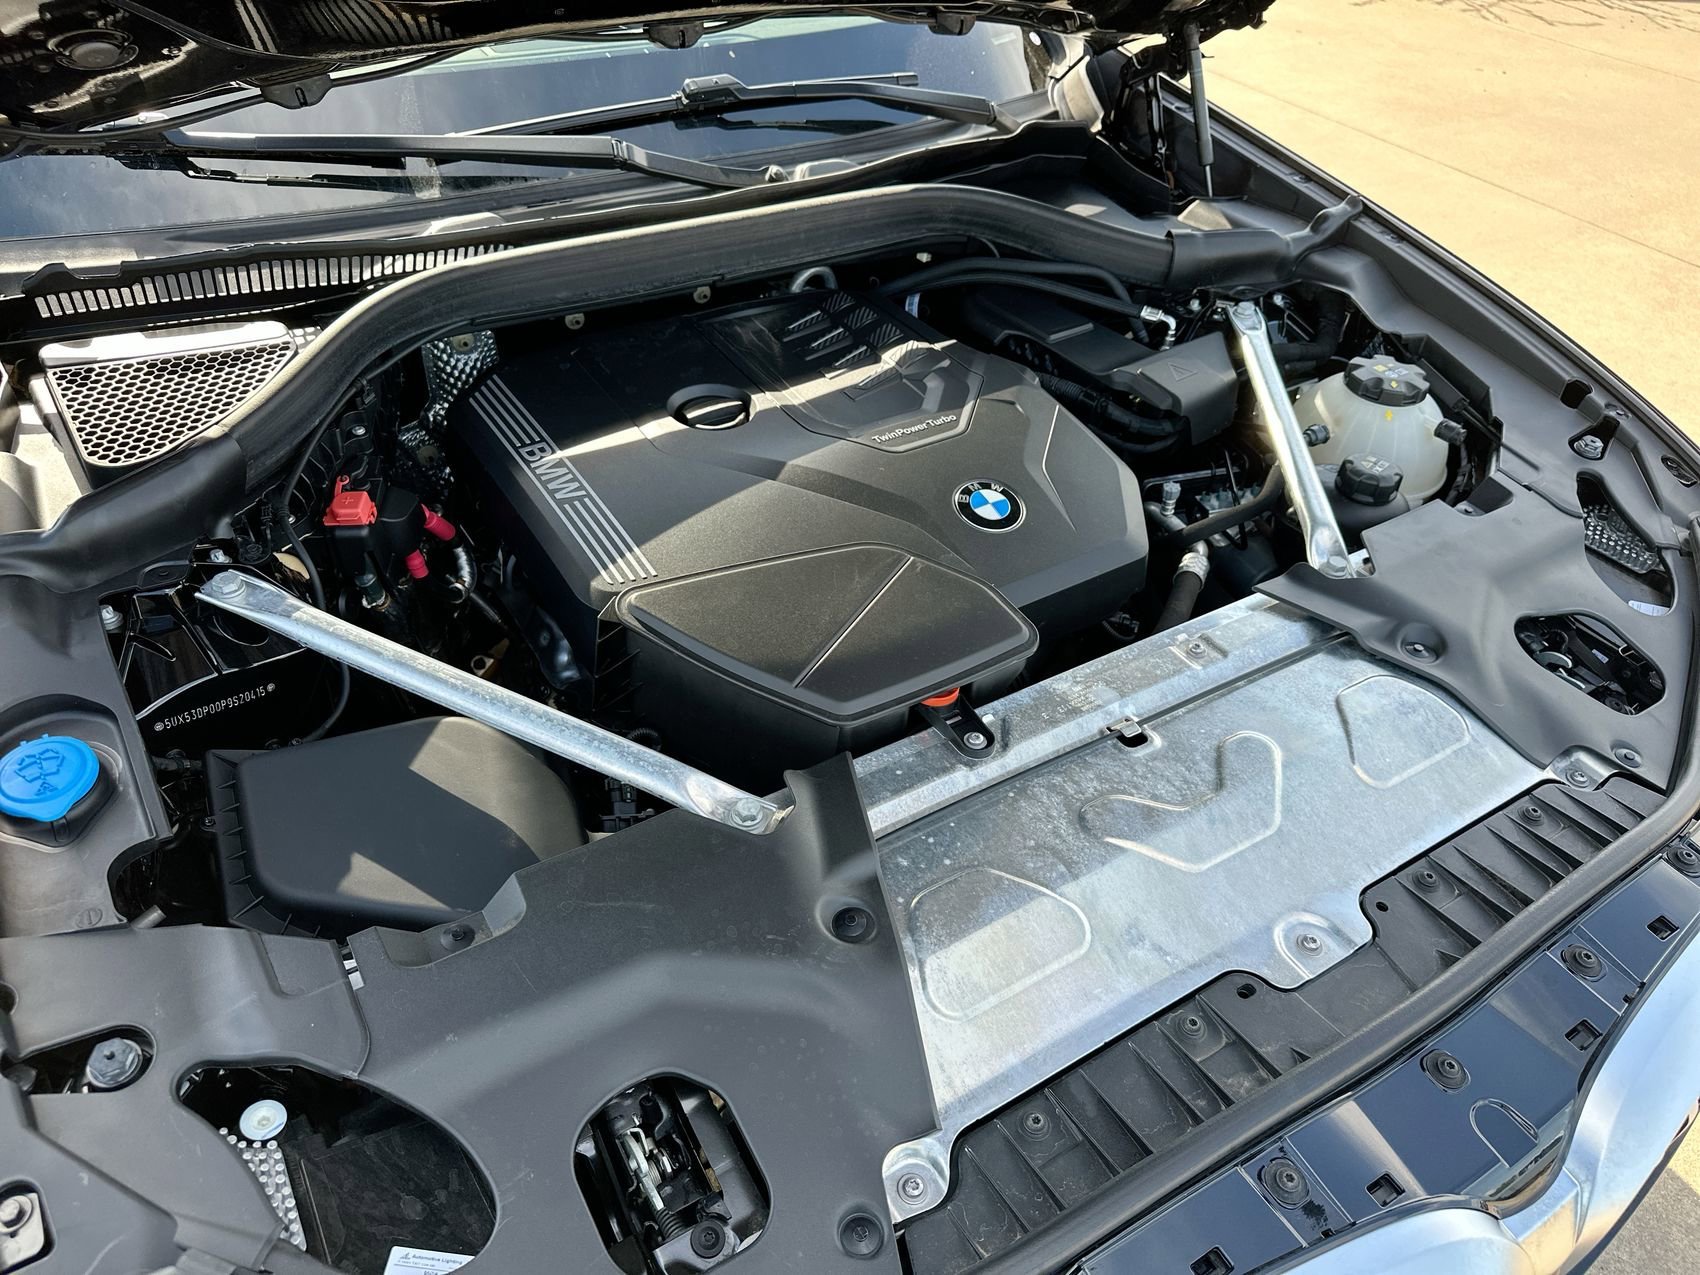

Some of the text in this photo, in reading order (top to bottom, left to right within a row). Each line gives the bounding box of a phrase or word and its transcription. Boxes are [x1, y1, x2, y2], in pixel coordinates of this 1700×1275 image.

[872, 415, 957, 443] TwinPower Turbo
[519, 441, 587, 500] BMW
[958, 483, 1004, 503] BMW
